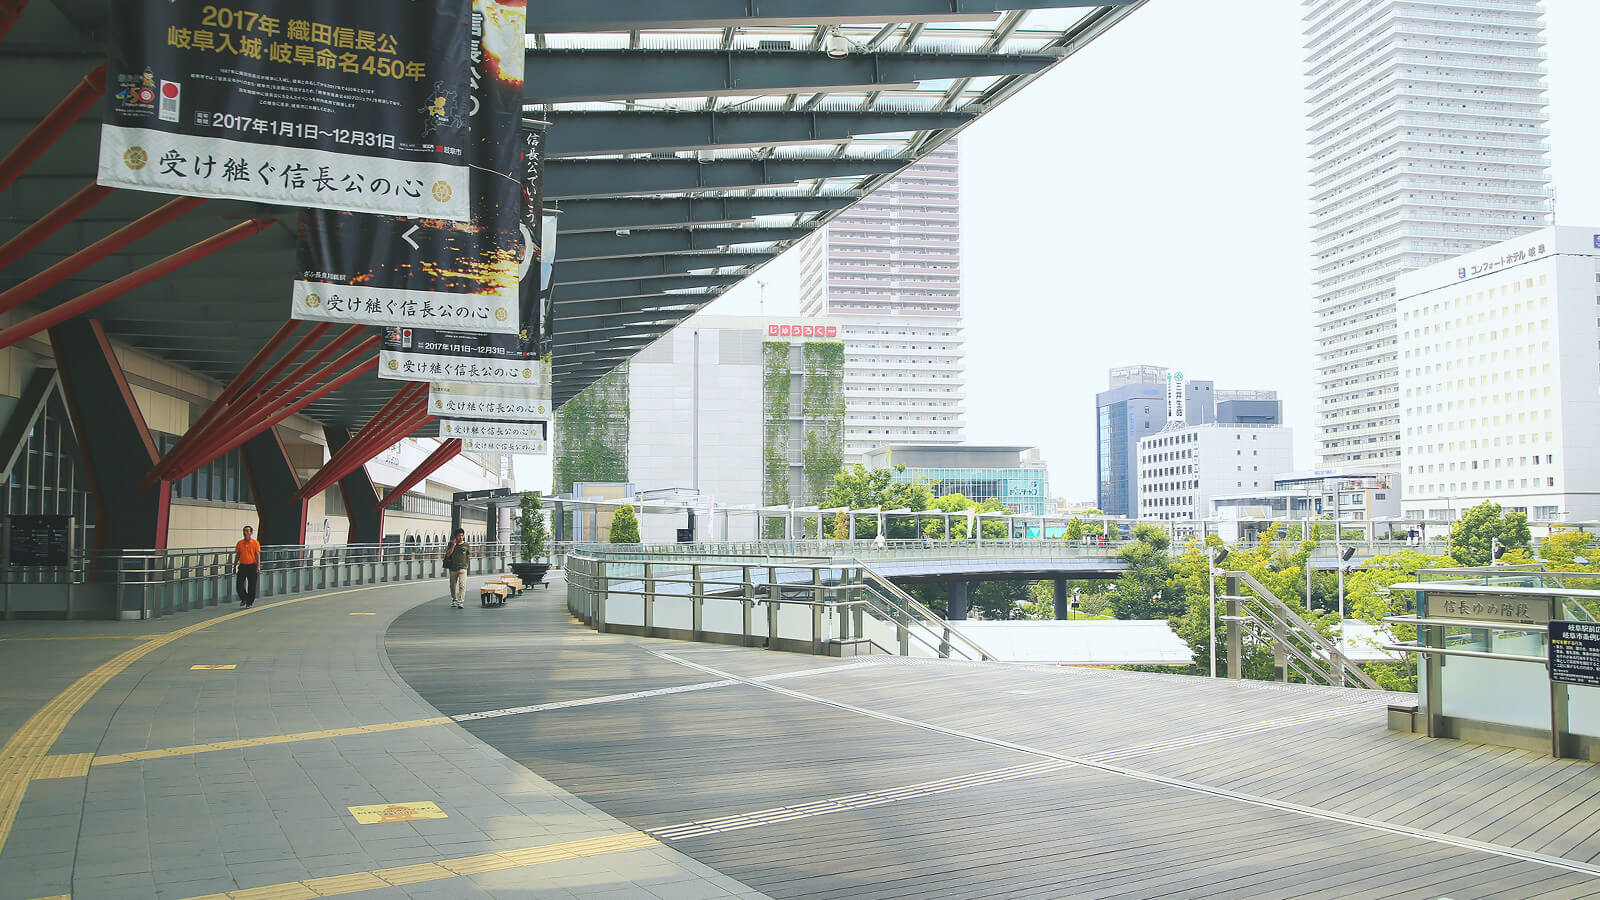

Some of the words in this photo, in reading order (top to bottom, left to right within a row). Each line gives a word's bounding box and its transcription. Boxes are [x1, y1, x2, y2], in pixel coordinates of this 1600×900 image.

[202, 6, 280, 37] 2017年
[288, 19, 398, 55] 織田信長公
[168, 26, 426, 81] 岐阜入城・岐阜命名450年
[160, 149, 424, 198] 受け継ぐ信長公の心
[327, 294, 490, 319] 受け継ぐ信長公の心
[403, 360, 518, 377] 受け継ぐ信長公の心
[446, 400, 535, 413] 受け継ぐ信長公の心
[453, 424, 528, 436] 受け継ぐ信長公の心
[474, 441, 535, 451] 受け継ぐ信長公の心
[1444, 599, 1530, 619] 信長ゆめ階段
